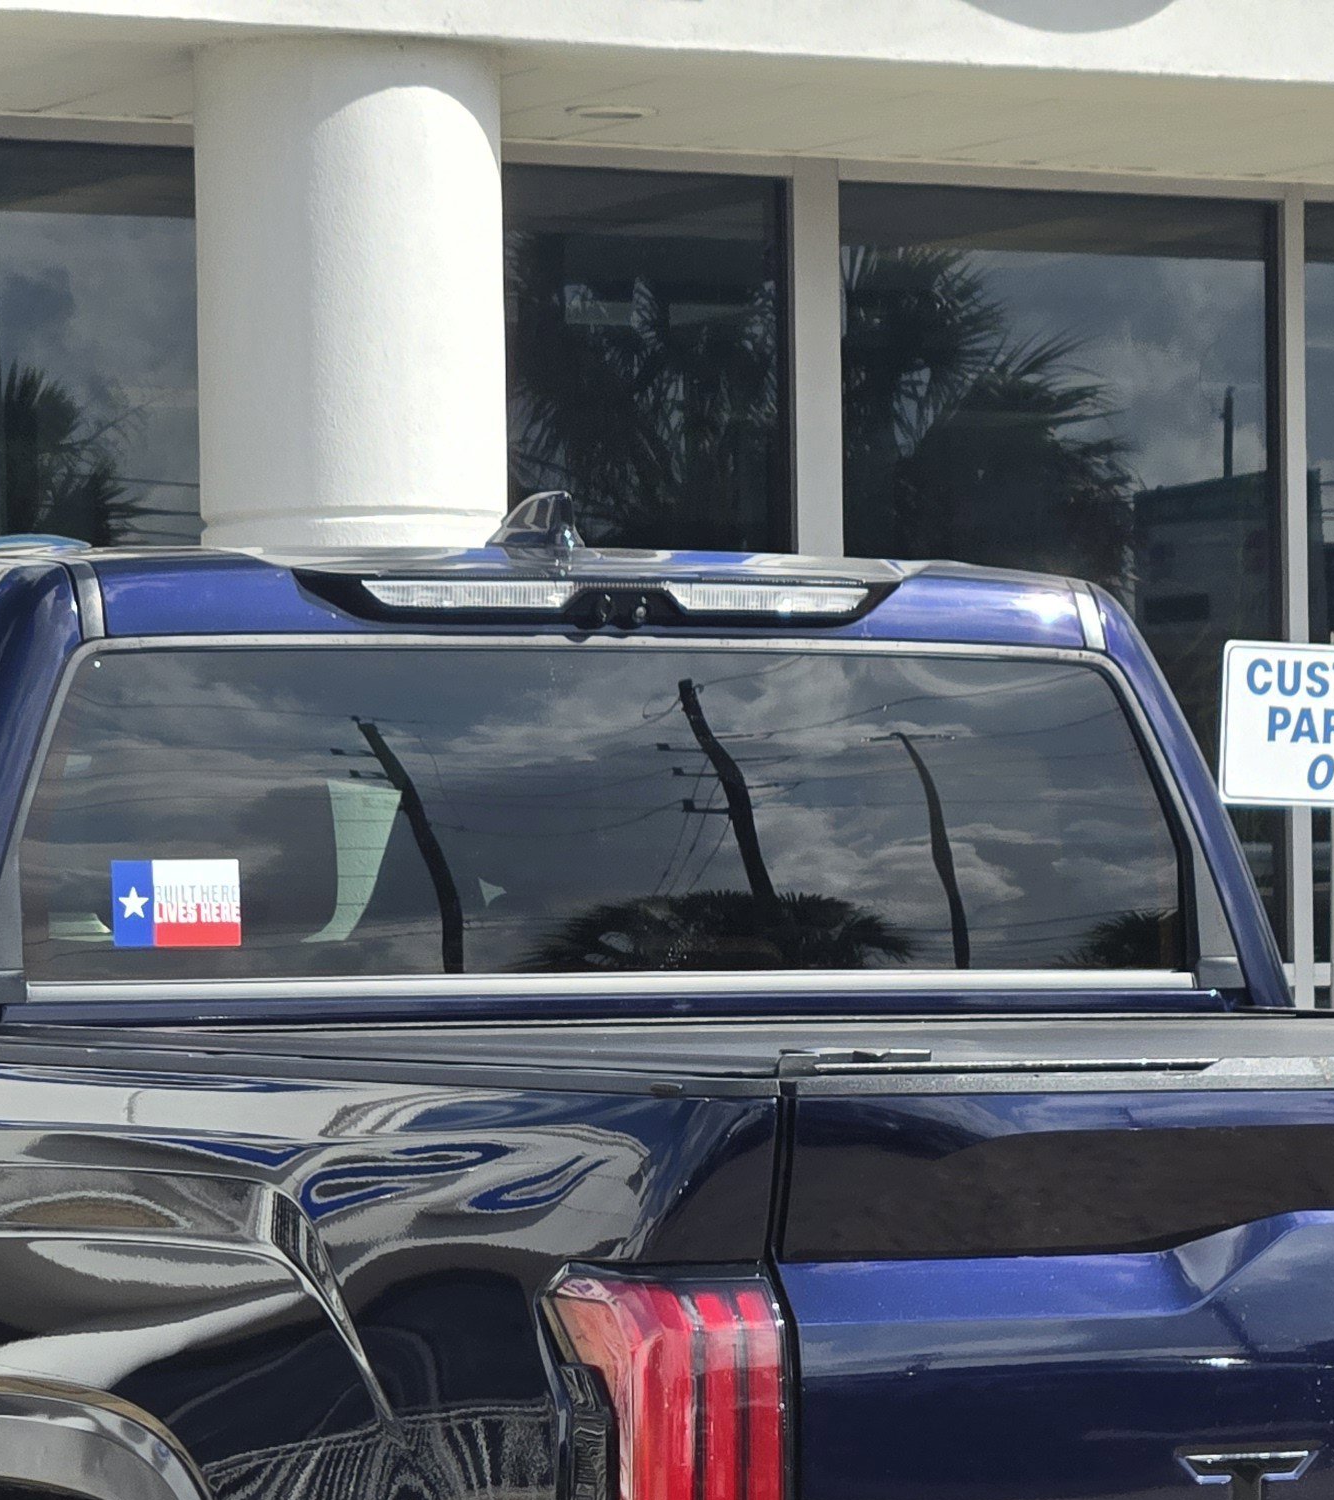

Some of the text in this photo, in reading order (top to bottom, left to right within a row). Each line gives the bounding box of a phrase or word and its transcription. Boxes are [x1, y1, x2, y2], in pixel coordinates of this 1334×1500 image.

[200, 885, 239, 903] HERE
[153, 902, 240, 923] LIVES HERE
